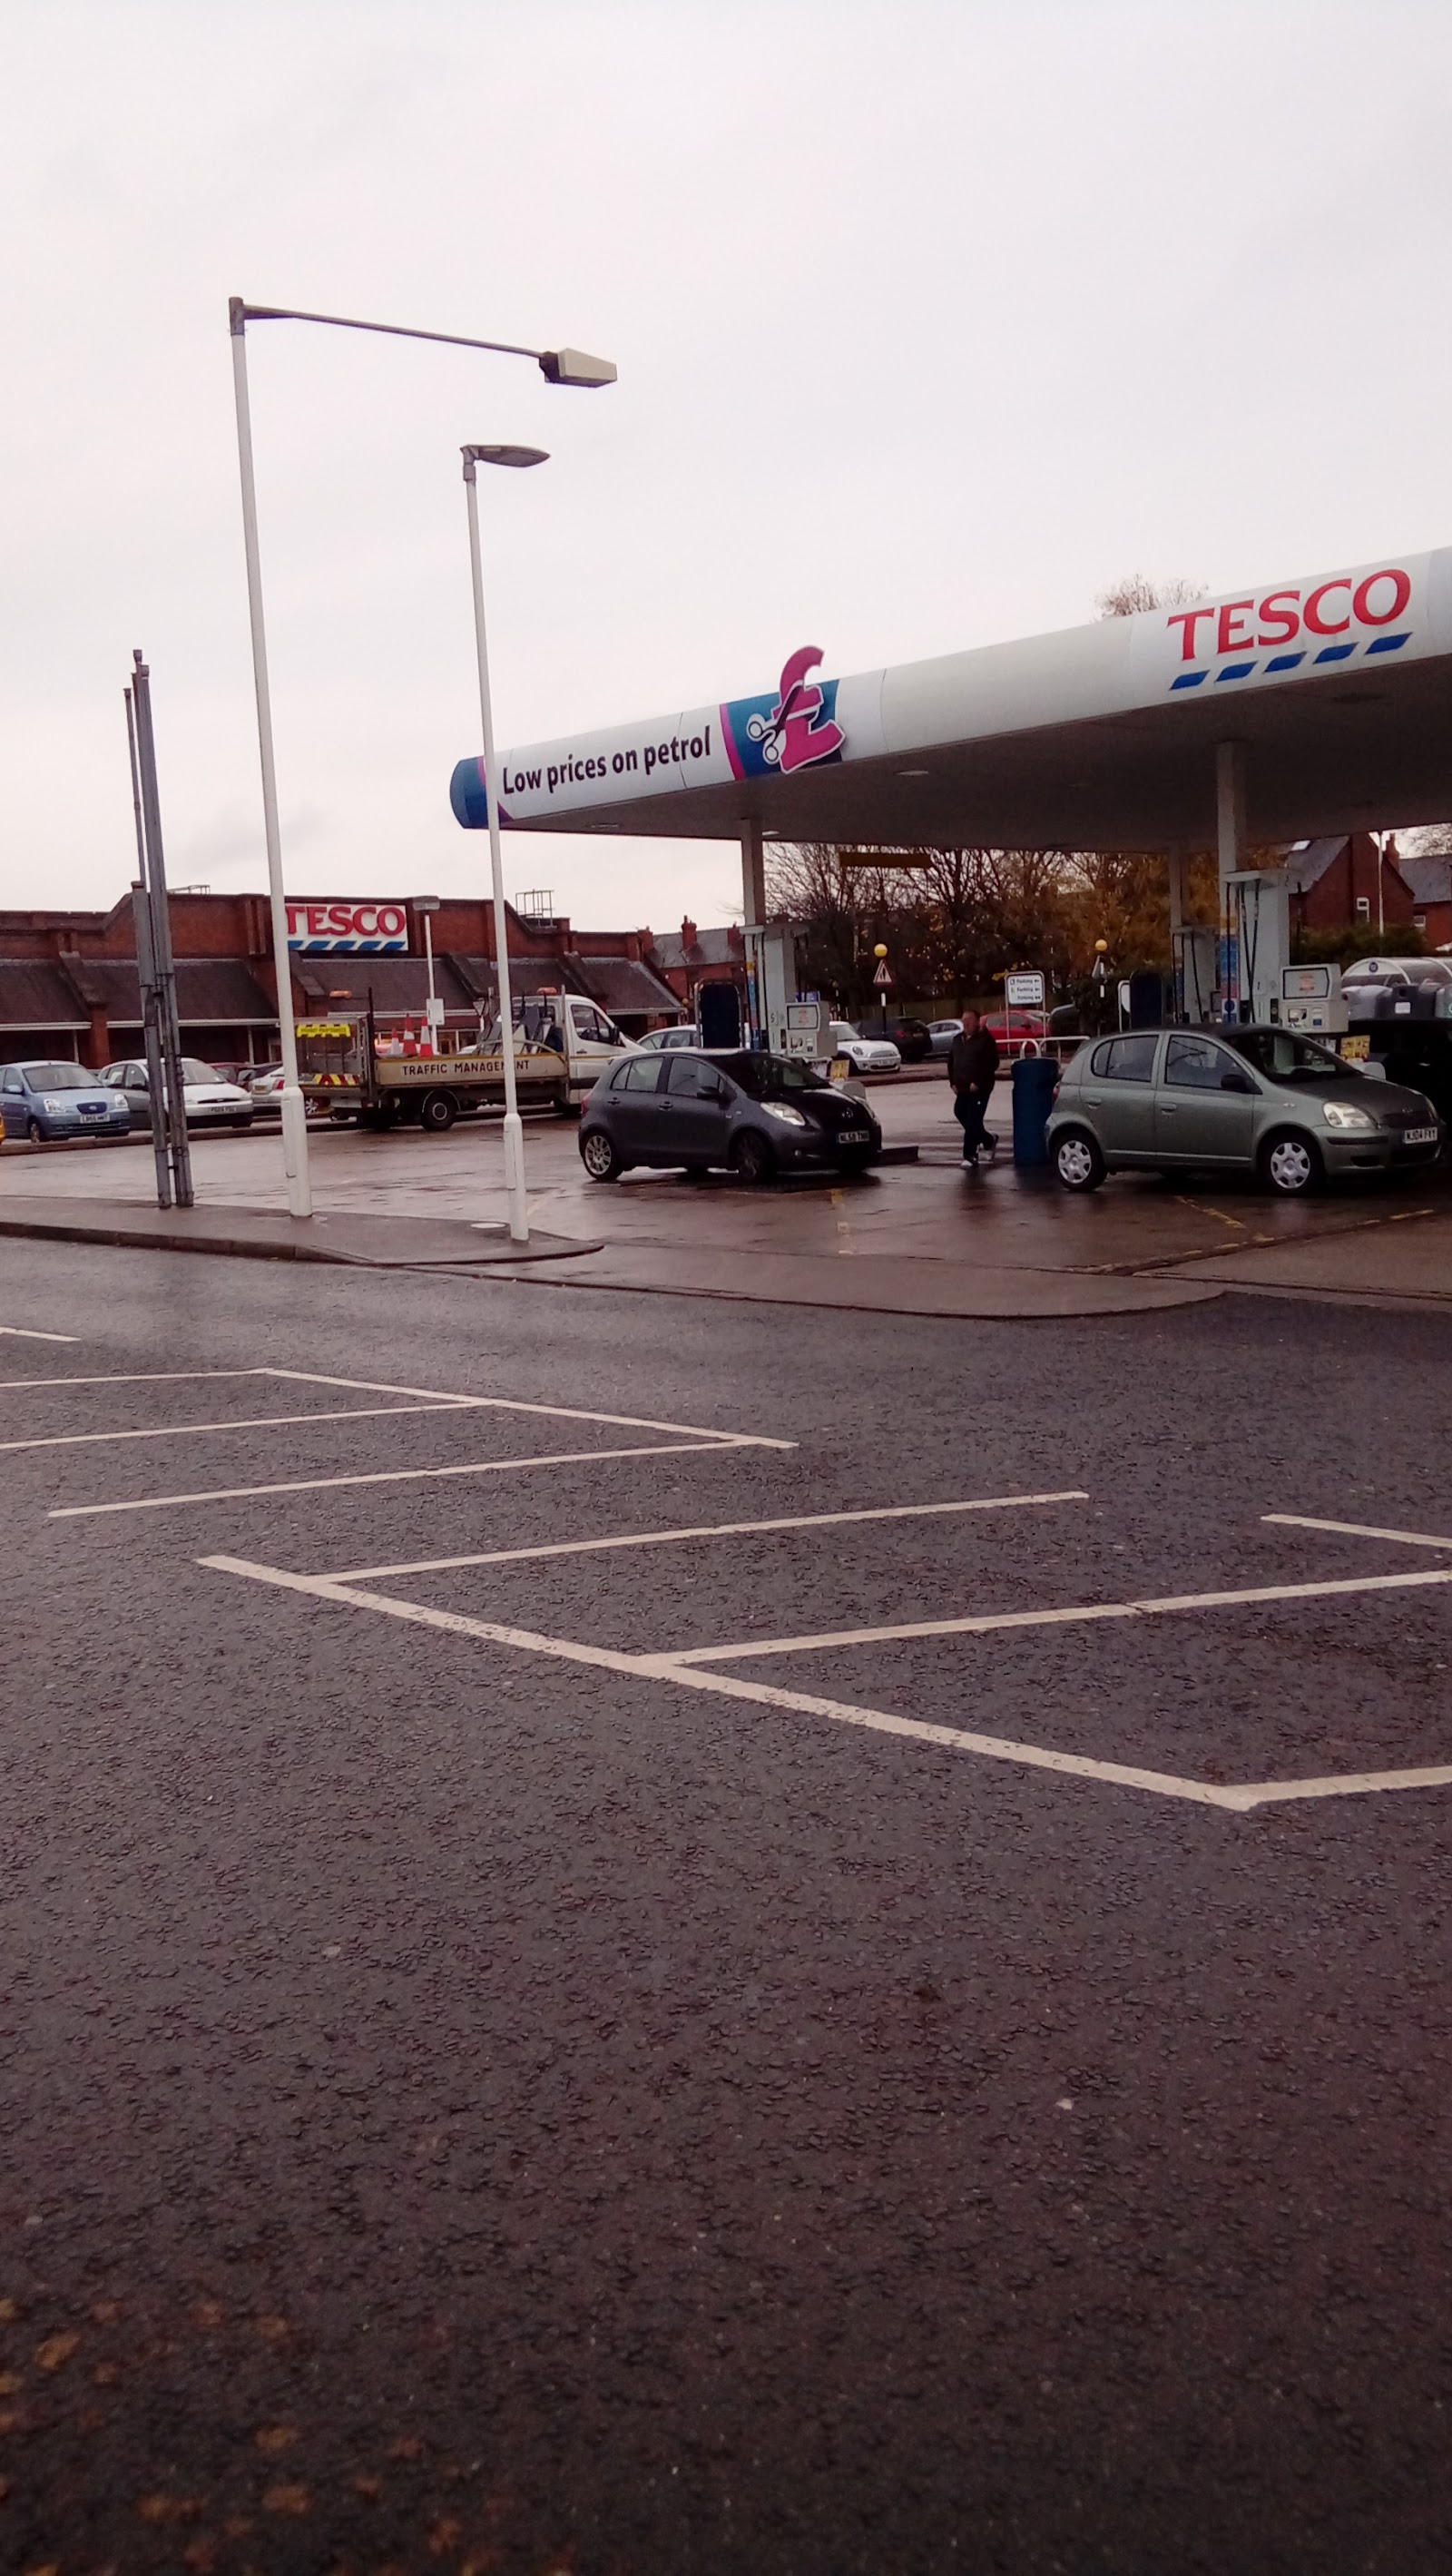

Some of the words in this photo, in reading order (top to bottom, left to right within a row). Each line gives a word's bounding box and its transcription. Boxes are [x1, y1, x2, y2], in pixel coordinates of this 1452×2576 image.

[1167, 569, 1411, 661] TESCO
[503, 767, 542, 795] Low
[546, 753, 607, 794] prices
[612, 749, 638, 773] on
[643, 725, 711, 775] petrol
[285, 906, 406, 936] TESCO
[403, 1063, 447, 1076] TRAFFIC
[454, 1059, 530, 1074] MANAGENT
